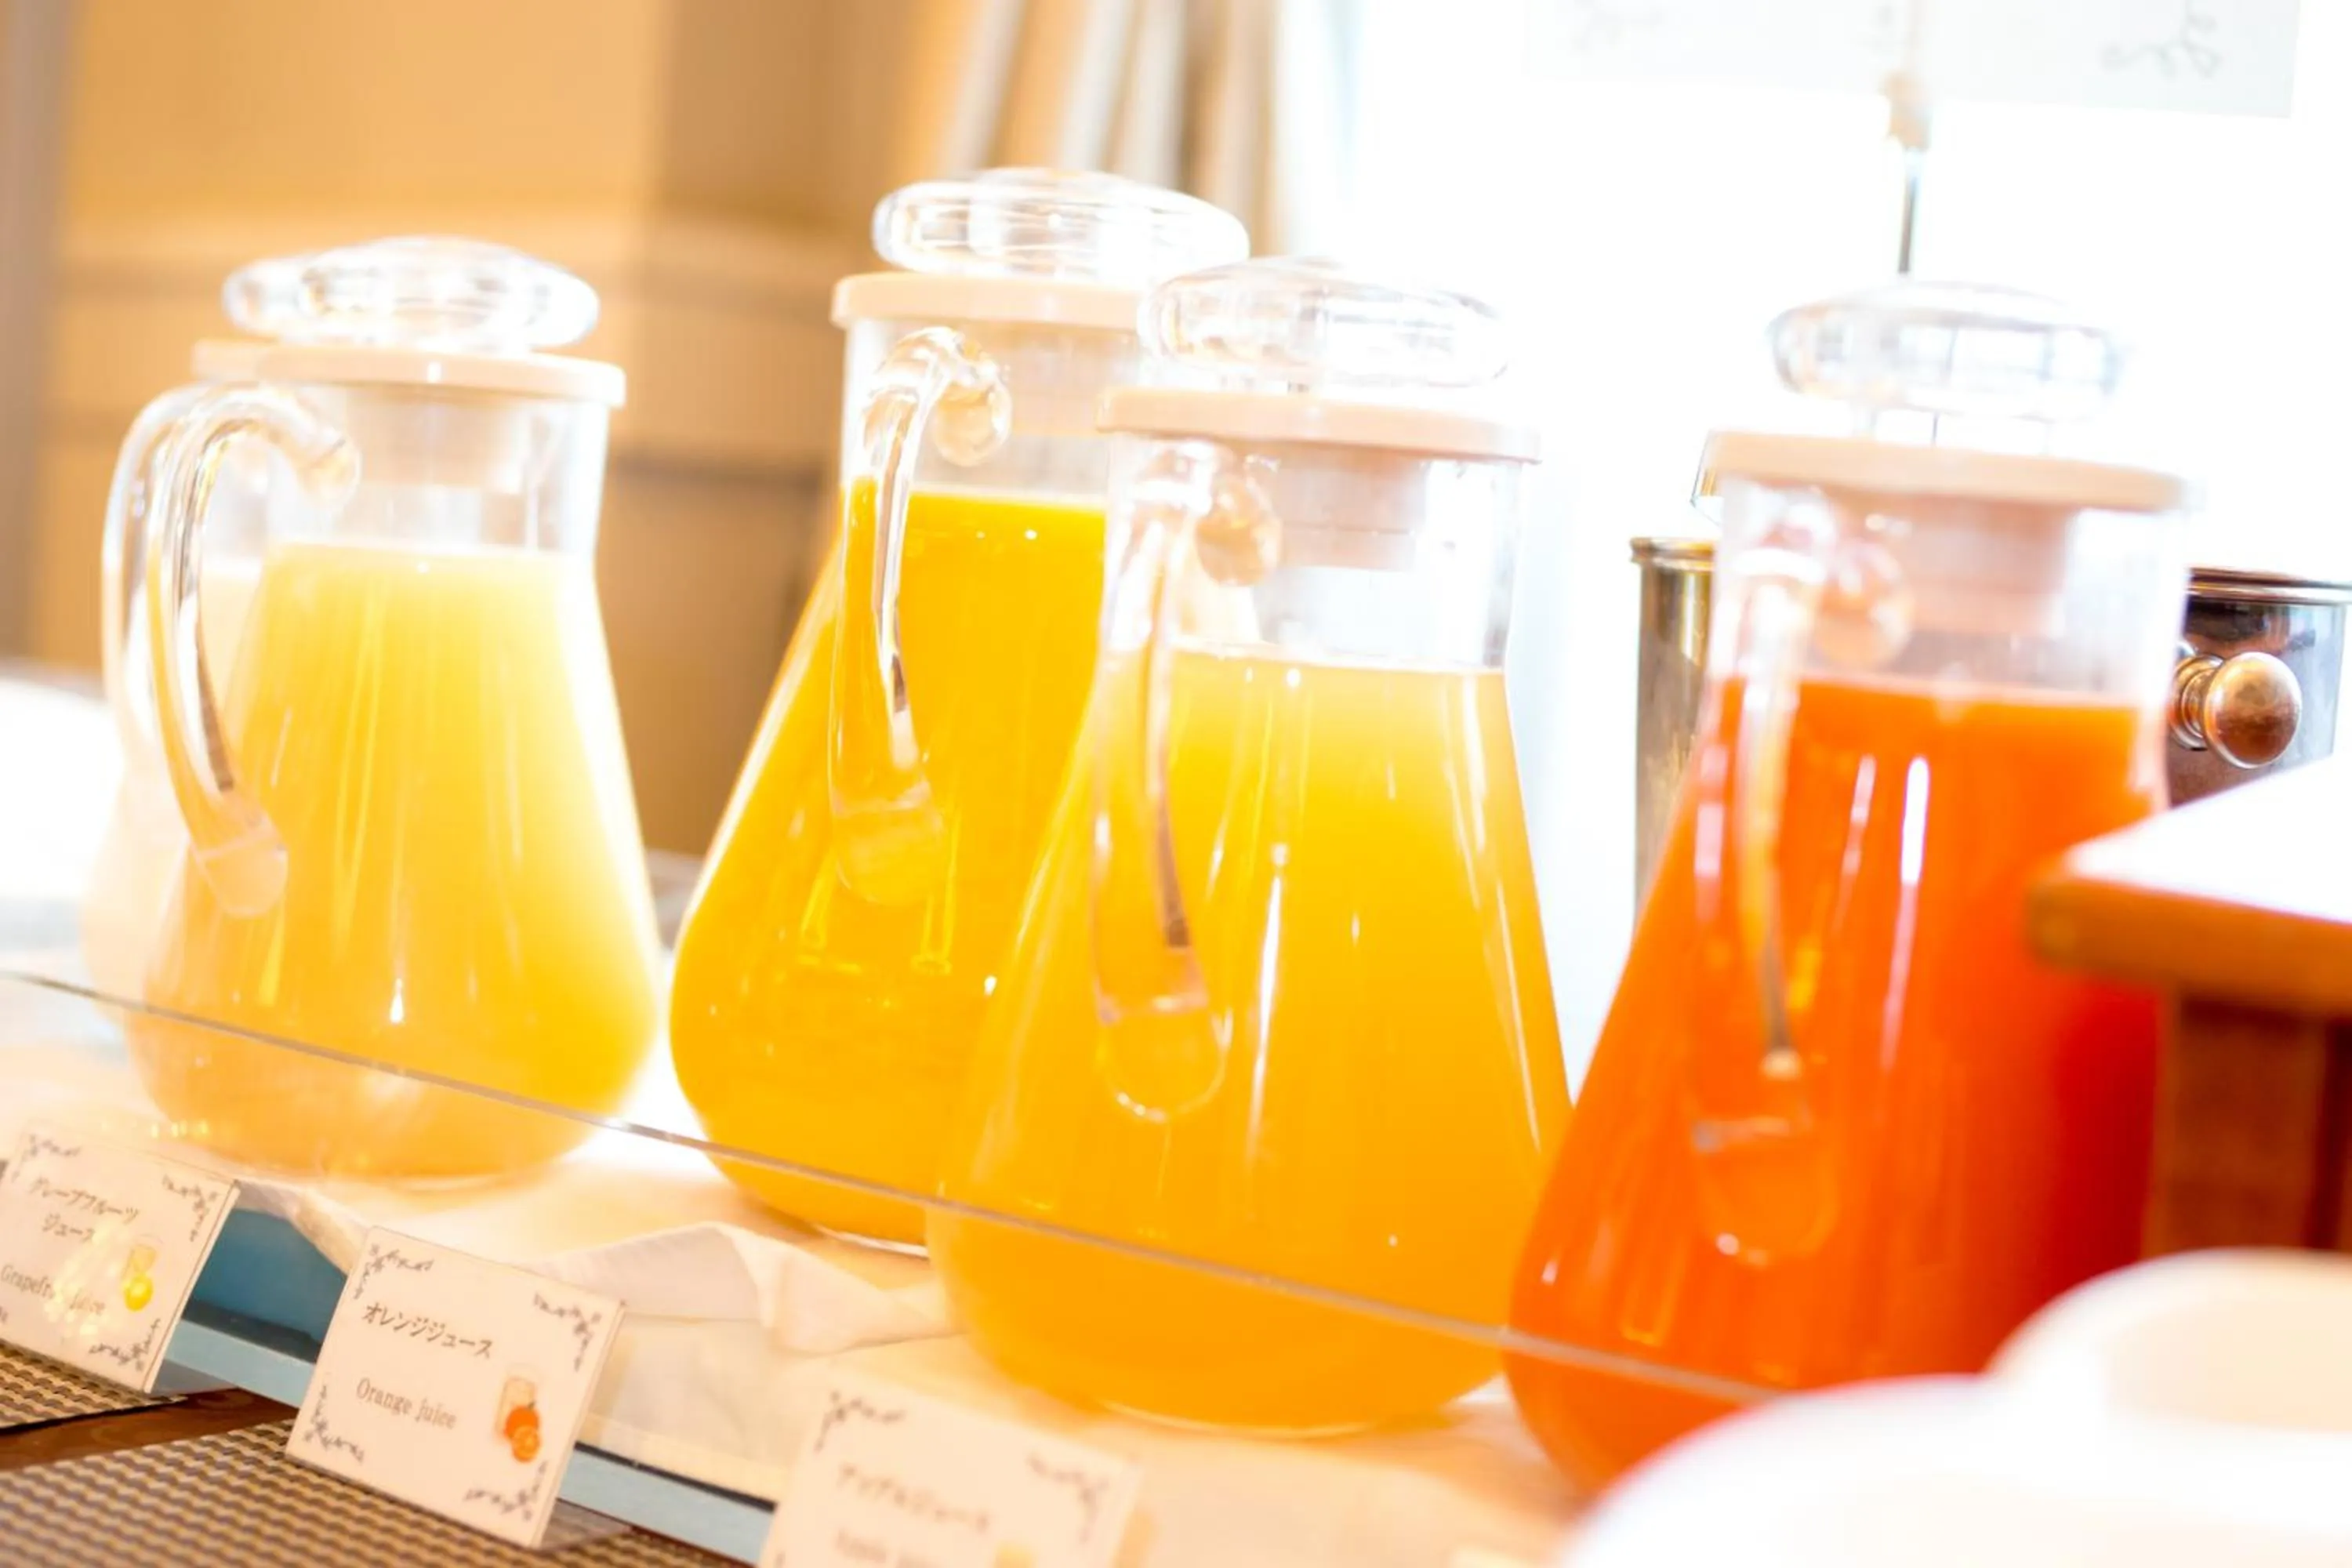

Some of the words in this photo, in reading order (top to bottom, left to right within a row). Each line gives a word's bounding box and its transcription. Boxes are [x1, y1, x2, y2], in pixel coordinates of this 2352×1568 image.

[1, 1264, 64, 1303] Grapefr
[363, 1303, 492, 1358] オレンジジュース
[357, 1378, 412, 1416] Orange
[416, 1399, 457, 1429] juice
